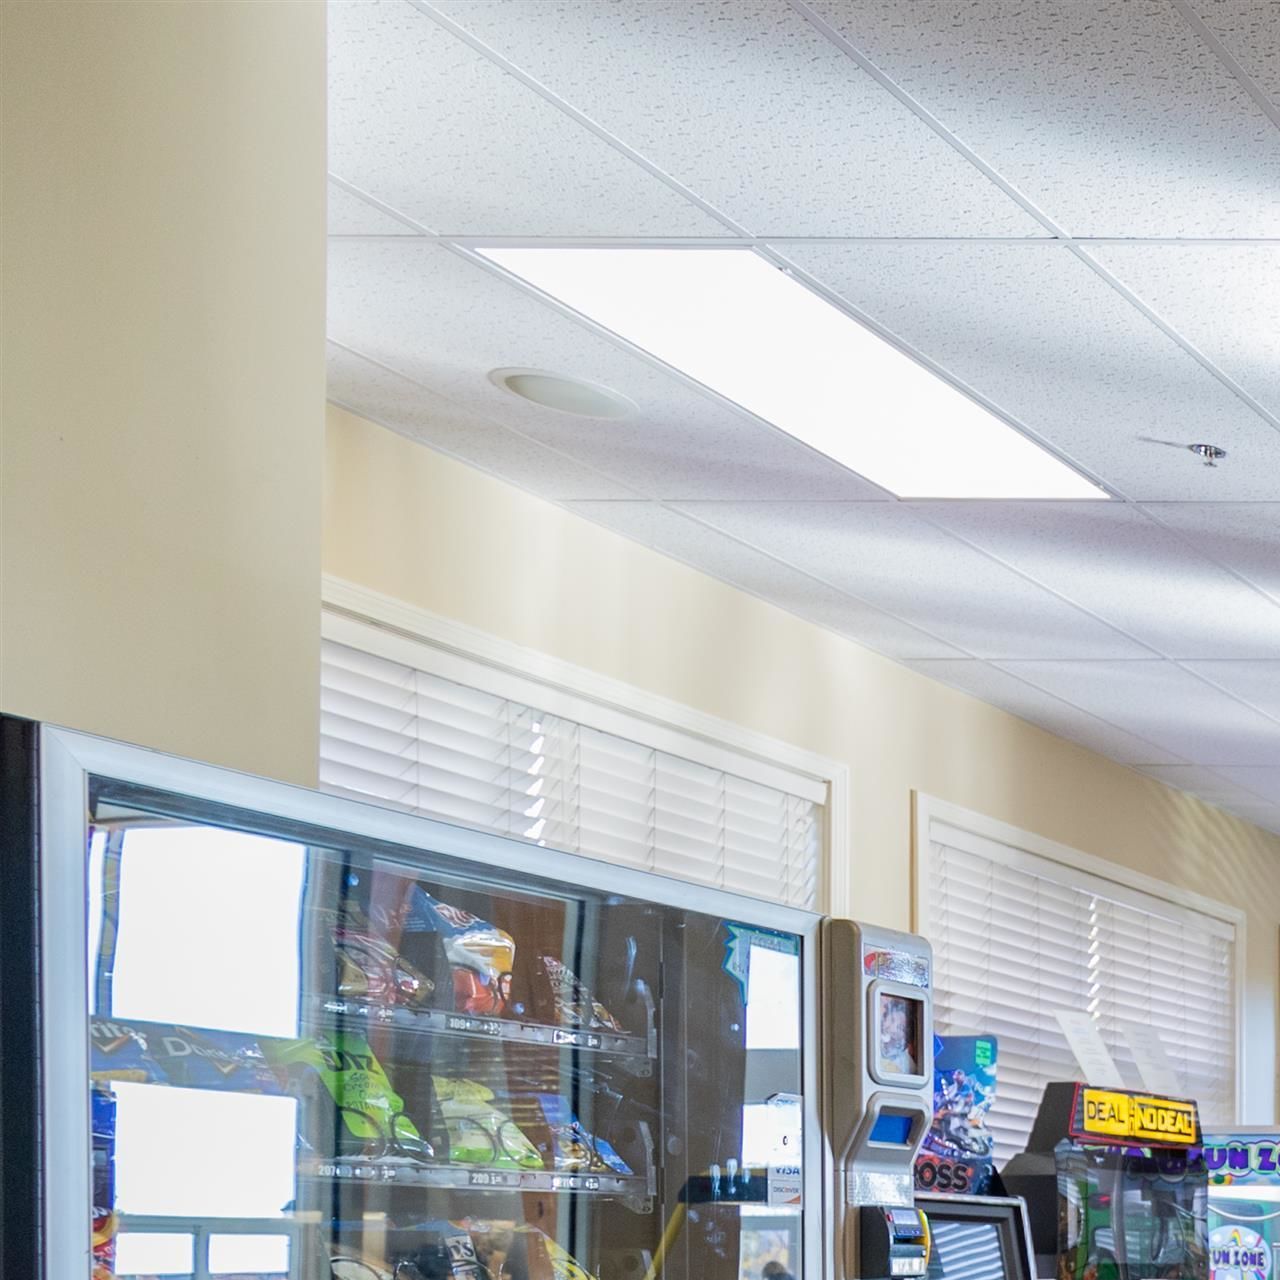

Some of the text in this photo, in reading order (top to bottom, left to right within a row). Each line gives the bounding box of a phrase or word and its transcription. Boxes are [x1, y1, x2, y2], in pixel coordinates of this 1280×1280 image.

[1086, 1101, 1125, 1123] DEAL
[1139, 1103, 1158, 1131] NO
[1158, 1108, 1192, 1134] DEAL
[1203, 1146, 1249, 1171] UN
[776, 1167, 800, 1176] VISA
[1212, 1249, 1265, 1268] UN ZONE
